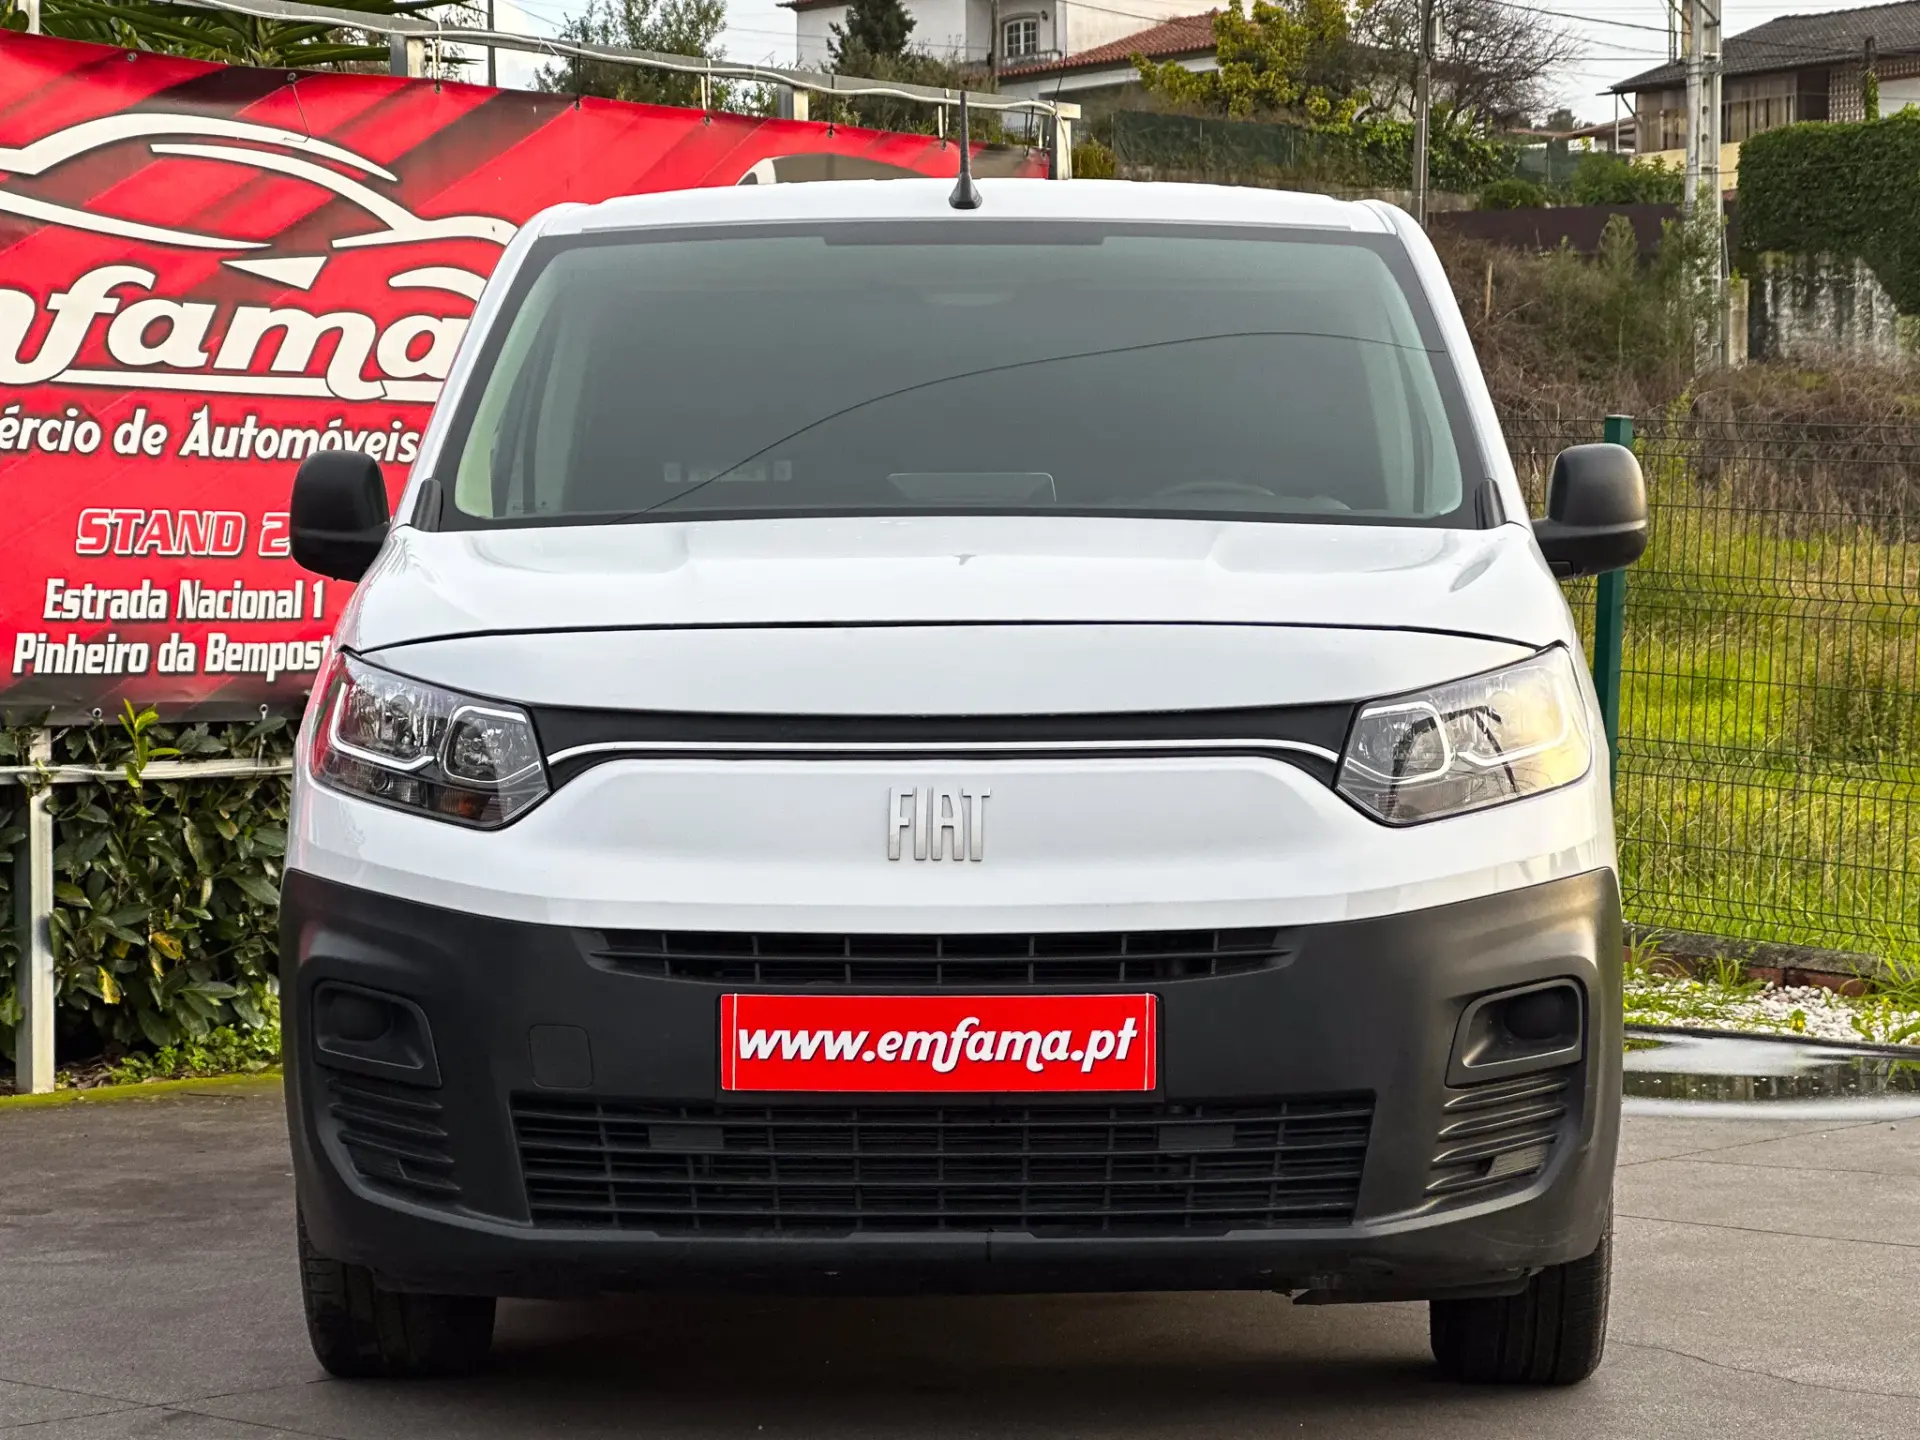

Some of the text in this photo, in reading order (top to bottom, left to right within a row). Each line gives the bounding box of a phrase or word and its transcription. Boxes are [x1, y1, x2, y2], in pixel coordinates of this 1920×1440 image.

[113, 407, 168, 456] de
[179, 404, 421, 462] Automóveis
[76, 508, 291, 557] STAND 2
[43, 577, 325, 620] Estrada Nacional 1
[12, 632, 149, 675] Pinheiro
[158, 633, 195, 673] da
[887, 786, 992, 862] FIAT
[738, 1017, 1138, 1073] www.emfama.pt
